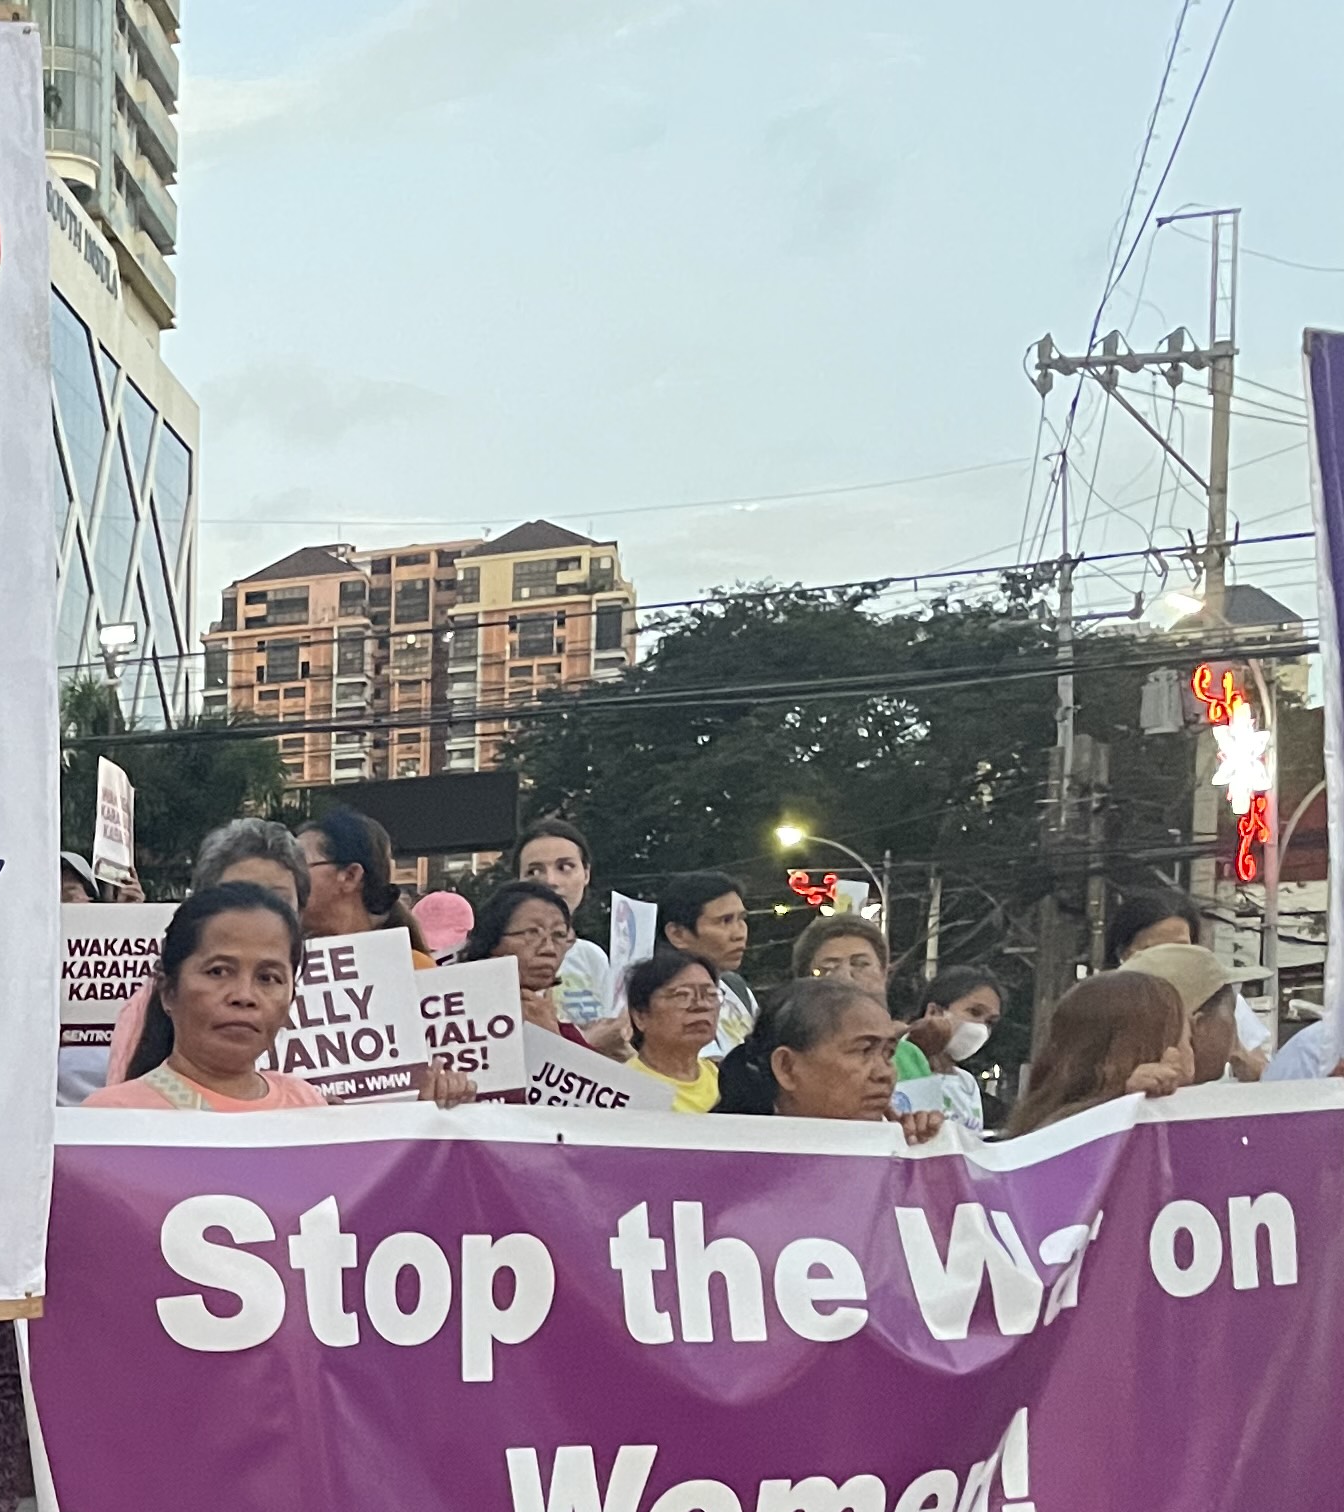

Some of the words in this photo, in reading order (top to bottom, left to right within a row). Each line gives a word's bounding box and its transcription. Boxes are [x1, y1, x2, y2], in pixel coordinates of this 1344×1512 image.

[67, 938, 161, 957] WAKASA
[62, 960, 153, 979] KARAHA
[303, 945, 359, 986] EE
[260, 1024, 399, 1074] JANO!
[315, 1080, 357, 1098] OMEN
[368, 1071, 411, 1091] WMW
[155, 1194, 556, 1383] Stop
[610, 1201, 870, 1344] the
[1149, 1192, 1299, 1298] on
